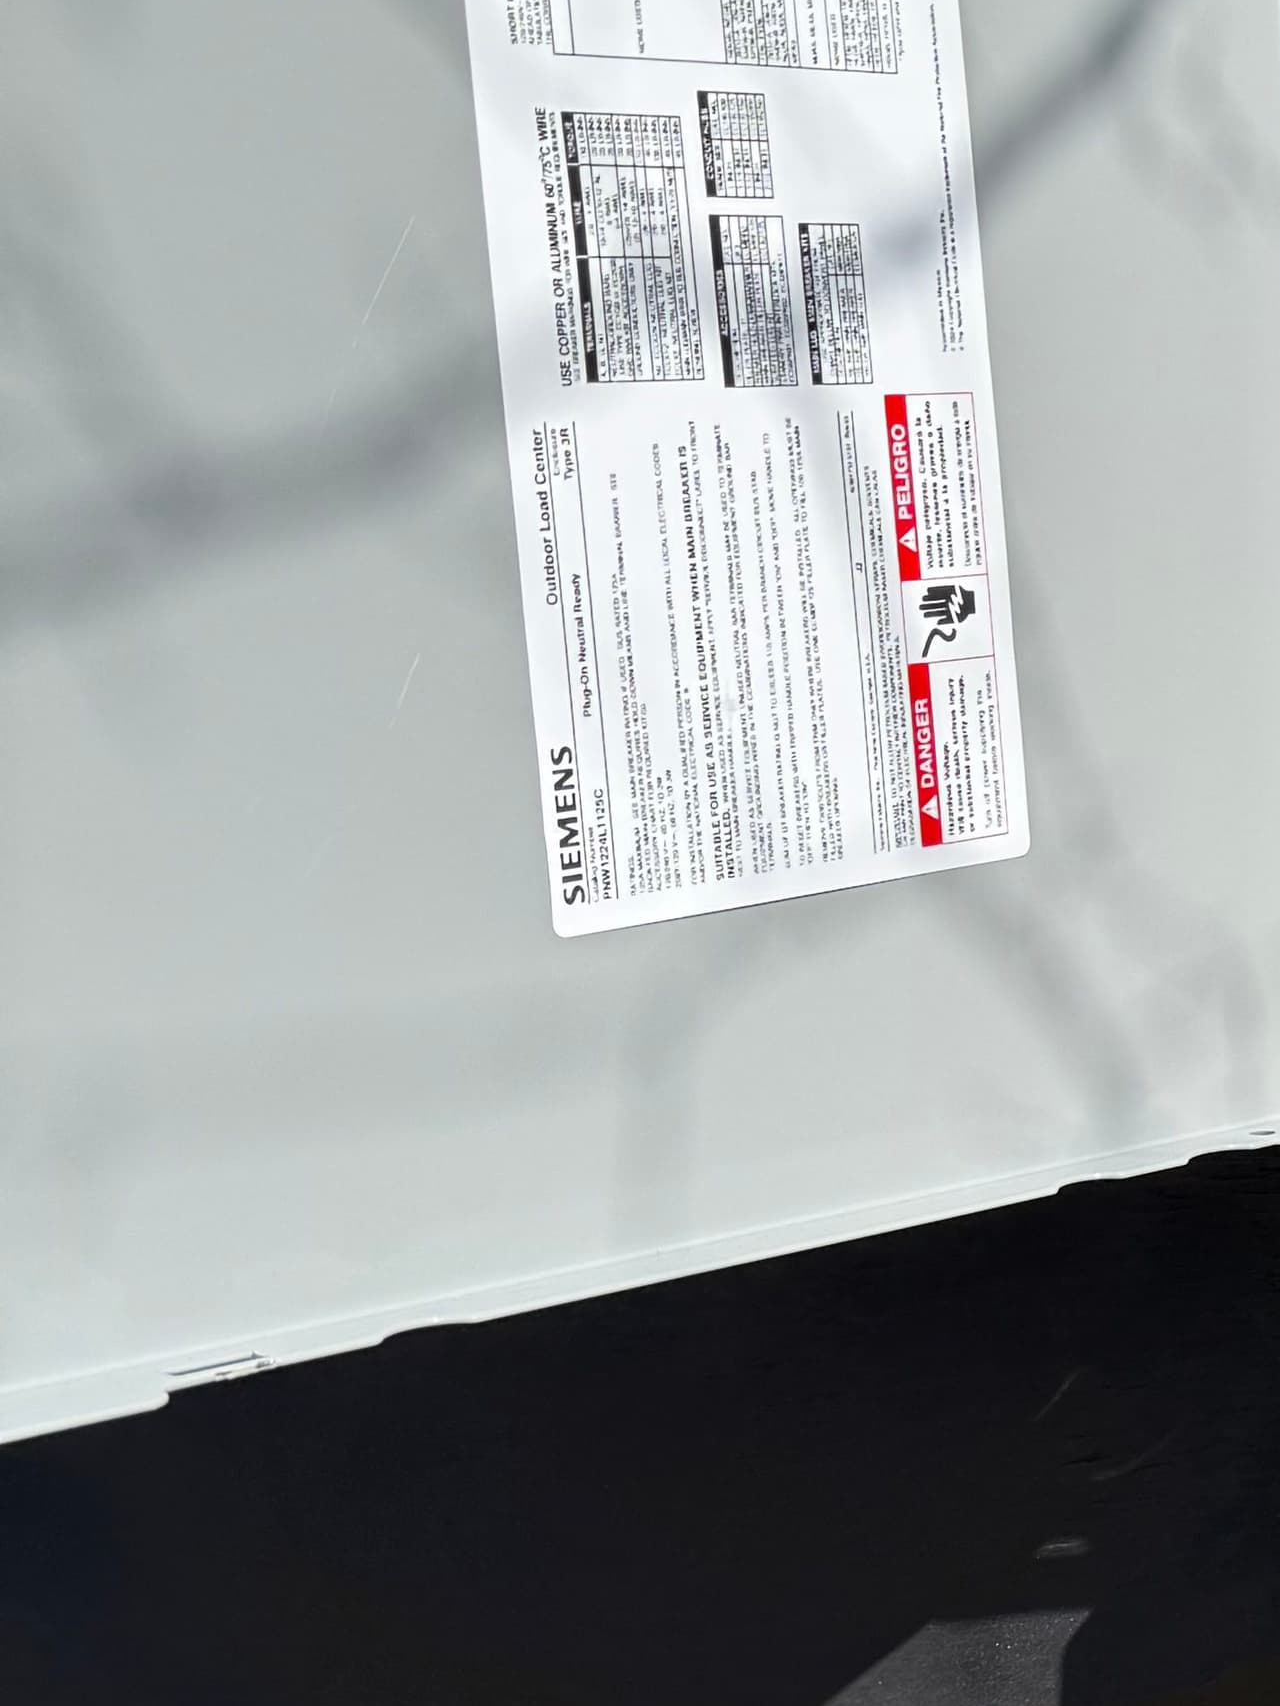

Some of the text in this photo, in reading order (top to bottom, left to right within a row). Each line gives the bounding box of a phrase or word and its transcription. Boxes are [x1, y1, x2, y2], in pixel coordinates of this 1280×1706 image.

[507, 5, 518, 44] SHORT
[535, 107, 549, 140] WIRE
[544, 202, 562, 272] ALUMINUM
[551, 278, 564, 297] OR
[554, 302, 570, 355] COPPER
[559, 360, 573, 385] USE
[559, 427, 575, 479] Type 3R
[676, 445, 686, 456] IS
[889, 422, 913, 519] PELIGRO
[529, 428, 558, 605] Outdoor Load Center
[678, 461, 692, 522] BREAKER
[684, 525, 696, 559] MAIN
[687, 562, 700, 601] WHEN
[570, 572, 594, 717] Plug-On Neutral Ready
[699, 683, 712, 737] SERVICE
[704, 741, 714, 758] AS
[914, 697, 935, 789] DANGER
[706, 761, 717, 787] USE
[548, 744, 586, 905] SIEMENS
[709, 790, 720, 817] FOR
[711, 819, 726, 881] SUITABLE
